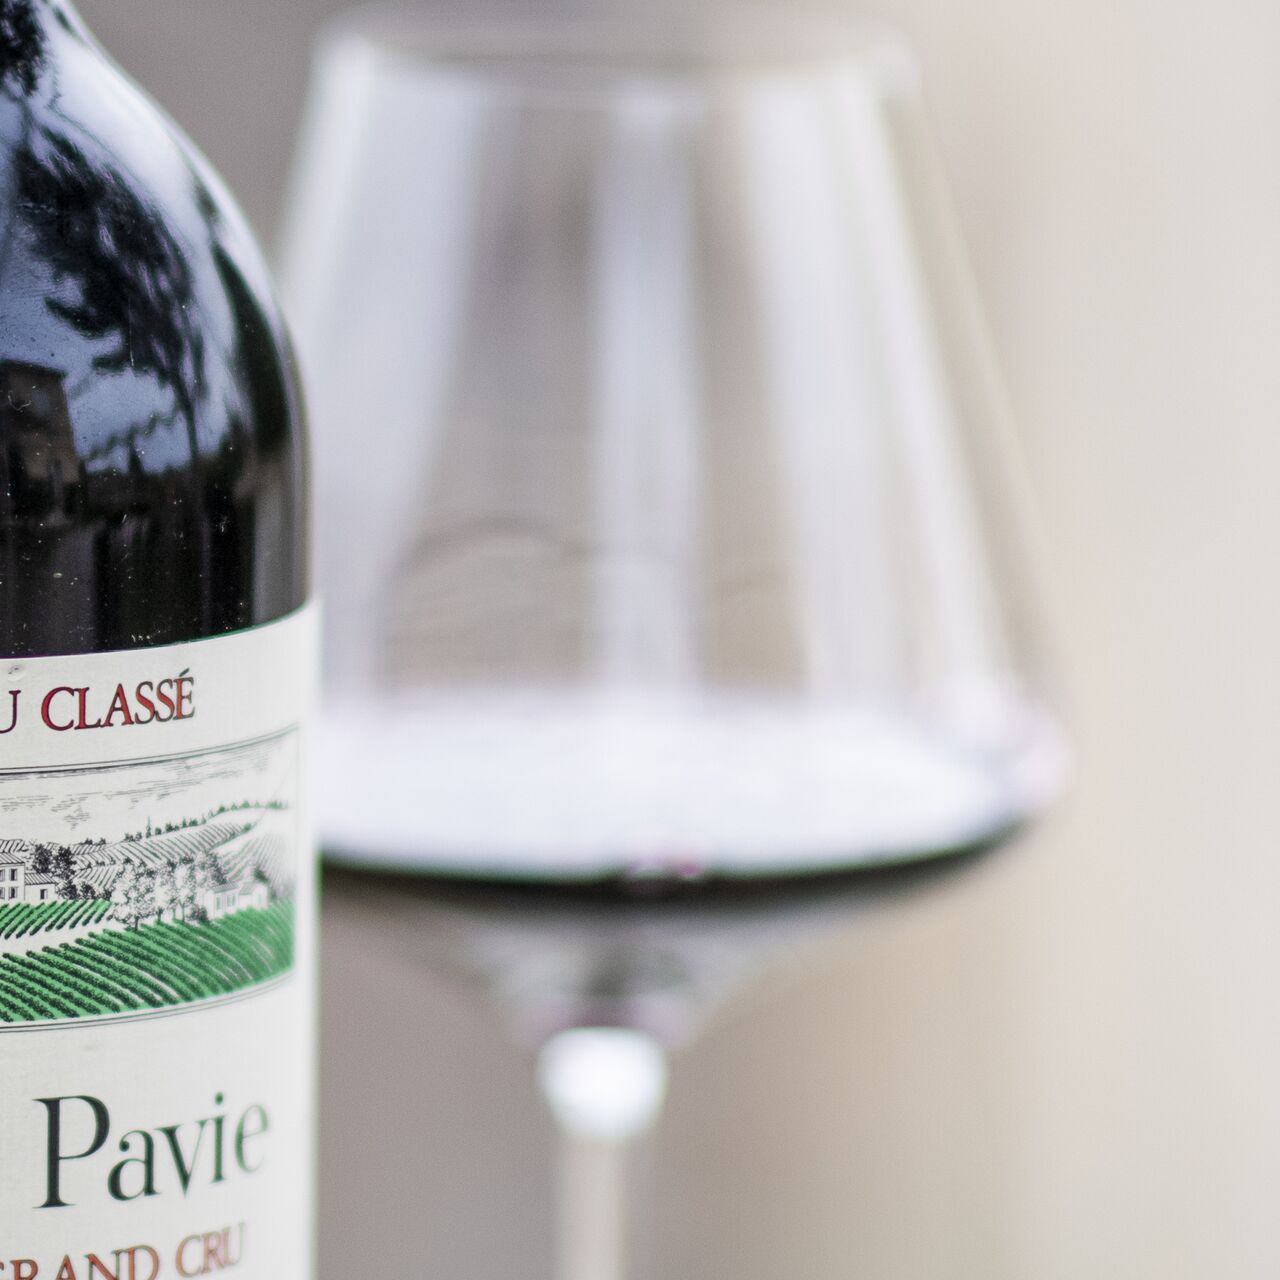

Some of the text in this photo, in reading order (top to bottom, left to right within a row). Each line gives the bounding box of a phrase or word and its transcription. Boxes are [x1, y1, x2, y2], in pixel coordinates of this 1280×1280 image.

[40, 667, 196, 732] CLASSÉ
[32, 1091, 272, 1211] Pavie
[175, 1220, 246, 1277] CRU
